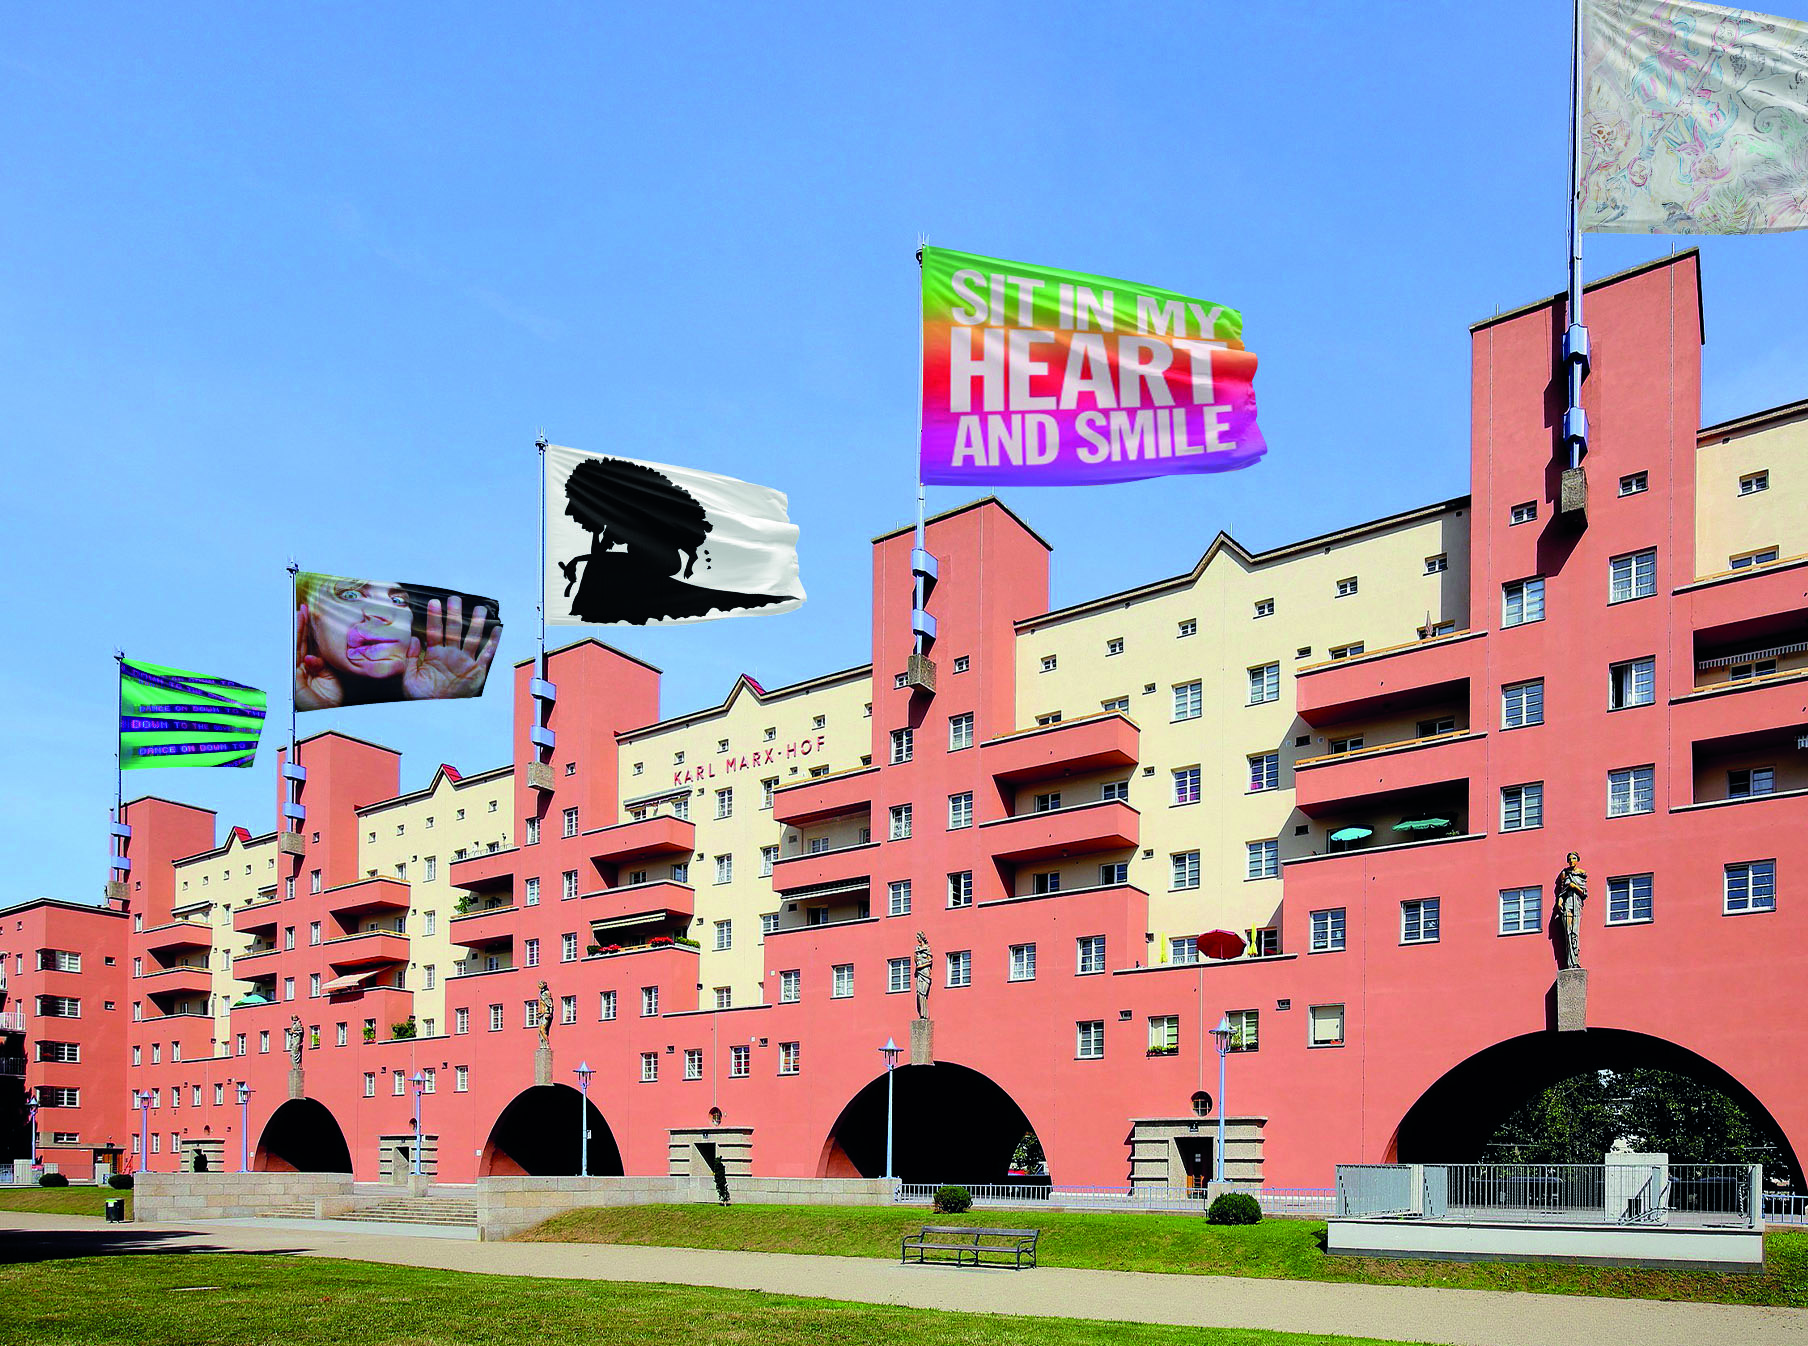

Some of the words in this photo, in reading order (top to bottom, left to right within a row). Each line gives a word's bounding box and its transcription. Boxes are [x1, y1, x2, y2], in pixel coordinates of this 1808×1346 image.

[951, 268, 1045, 328] SIT
[1059, 282, 1115, 333] IN
[1136, 294, 1224, 340] MY
[950, 326, 1228, 413] HEART
[951, 413, 1060, 467] AND
[1074, 404, 1237, 465] SMILE
[192, 705, 219, 713] DOWN
[131, 719, 168, 729] DOWN
[173, 721, 188, 729] TO
[192, 722, 209, 730] THE
[138, 746, 176, 756] DANCE
[181, 745, 196, 753] ON
[199, 744, 227, 752] DOWN
[674, 763, 716, 787] KARL
